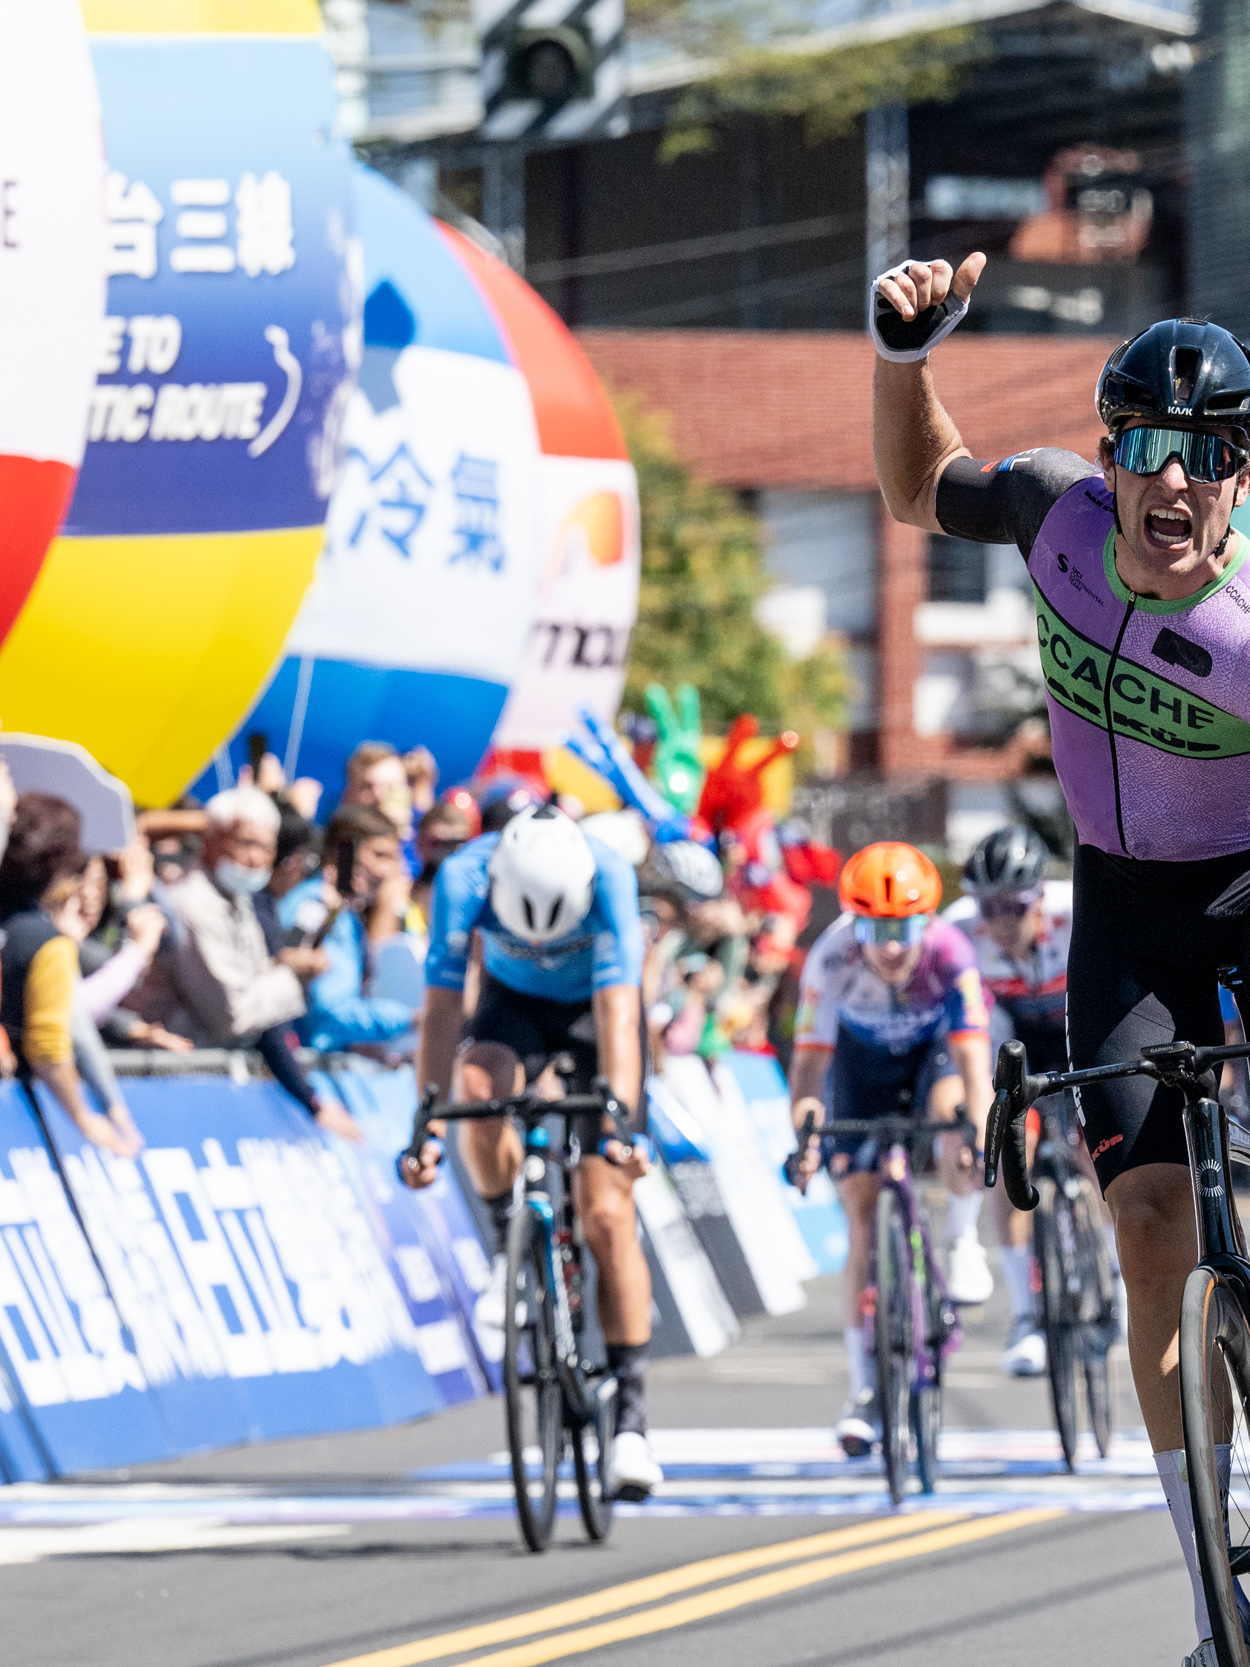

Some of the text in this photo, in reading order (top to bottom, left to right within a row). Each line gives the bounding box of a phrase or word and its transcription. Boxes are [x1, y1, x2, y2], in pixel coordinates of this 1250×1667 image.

[128, 313, 183, 375] TO
[151, 380, 268, 442] ROUTE
[1069, 571, 1105, 608] CONTINENTAL
[1072, 565, 1083, 579] UCI
[1036, 613, 1215, 731] CCACHE
[1150, 1045, 1174, 1054] GARMIN
